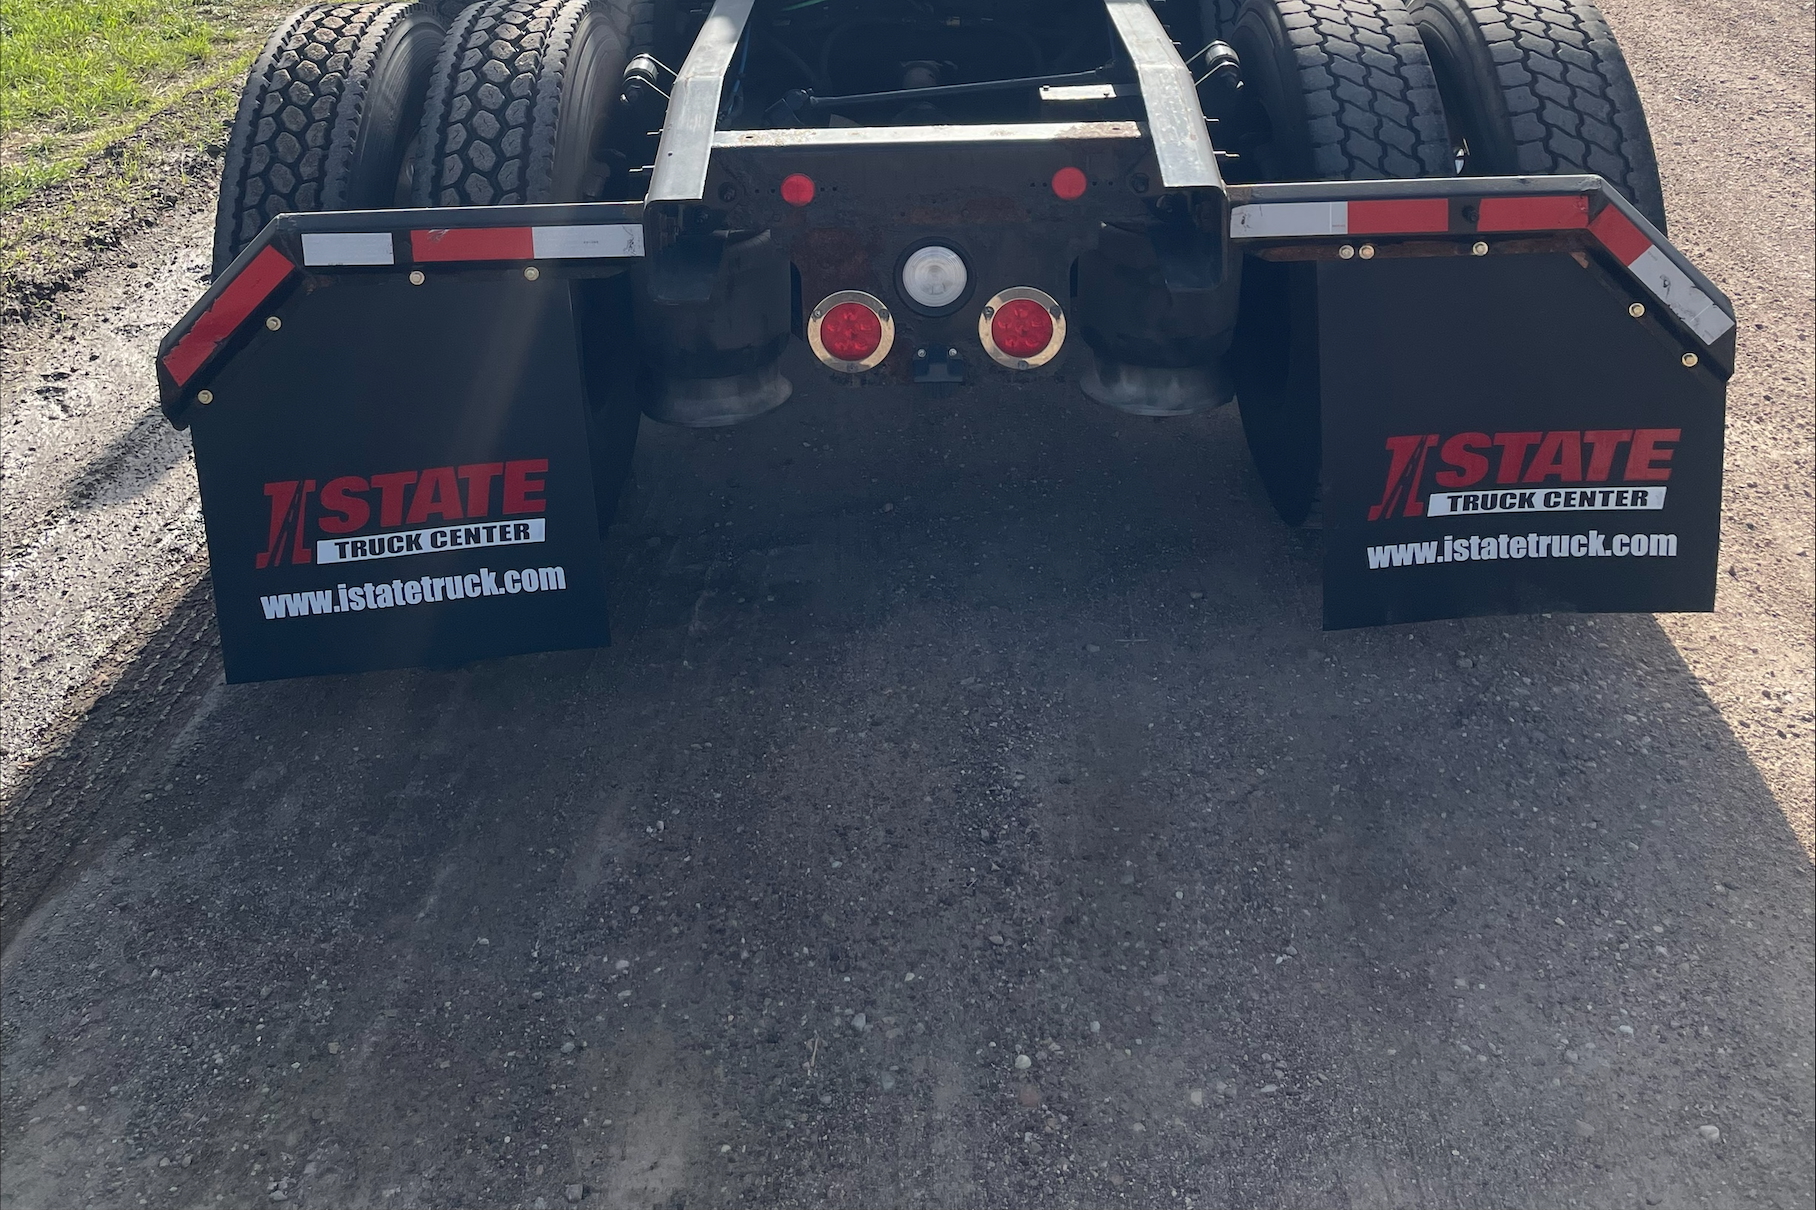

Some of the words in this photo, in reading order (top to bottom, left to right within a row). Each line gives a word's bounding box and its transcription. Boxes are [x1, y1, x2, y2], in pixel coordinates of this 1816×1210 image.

[1447, 491, 1537, 512] TRUCK
[1543, 489, 1648, 509] CENTER
[335, 532, 424, 559] TRUCK
[430, 522, 531, 549] CENTER
[1367, 530, 1677, 569] www.istatetruck.com
[260, 566, 567, 620] www.istatetruck.com
